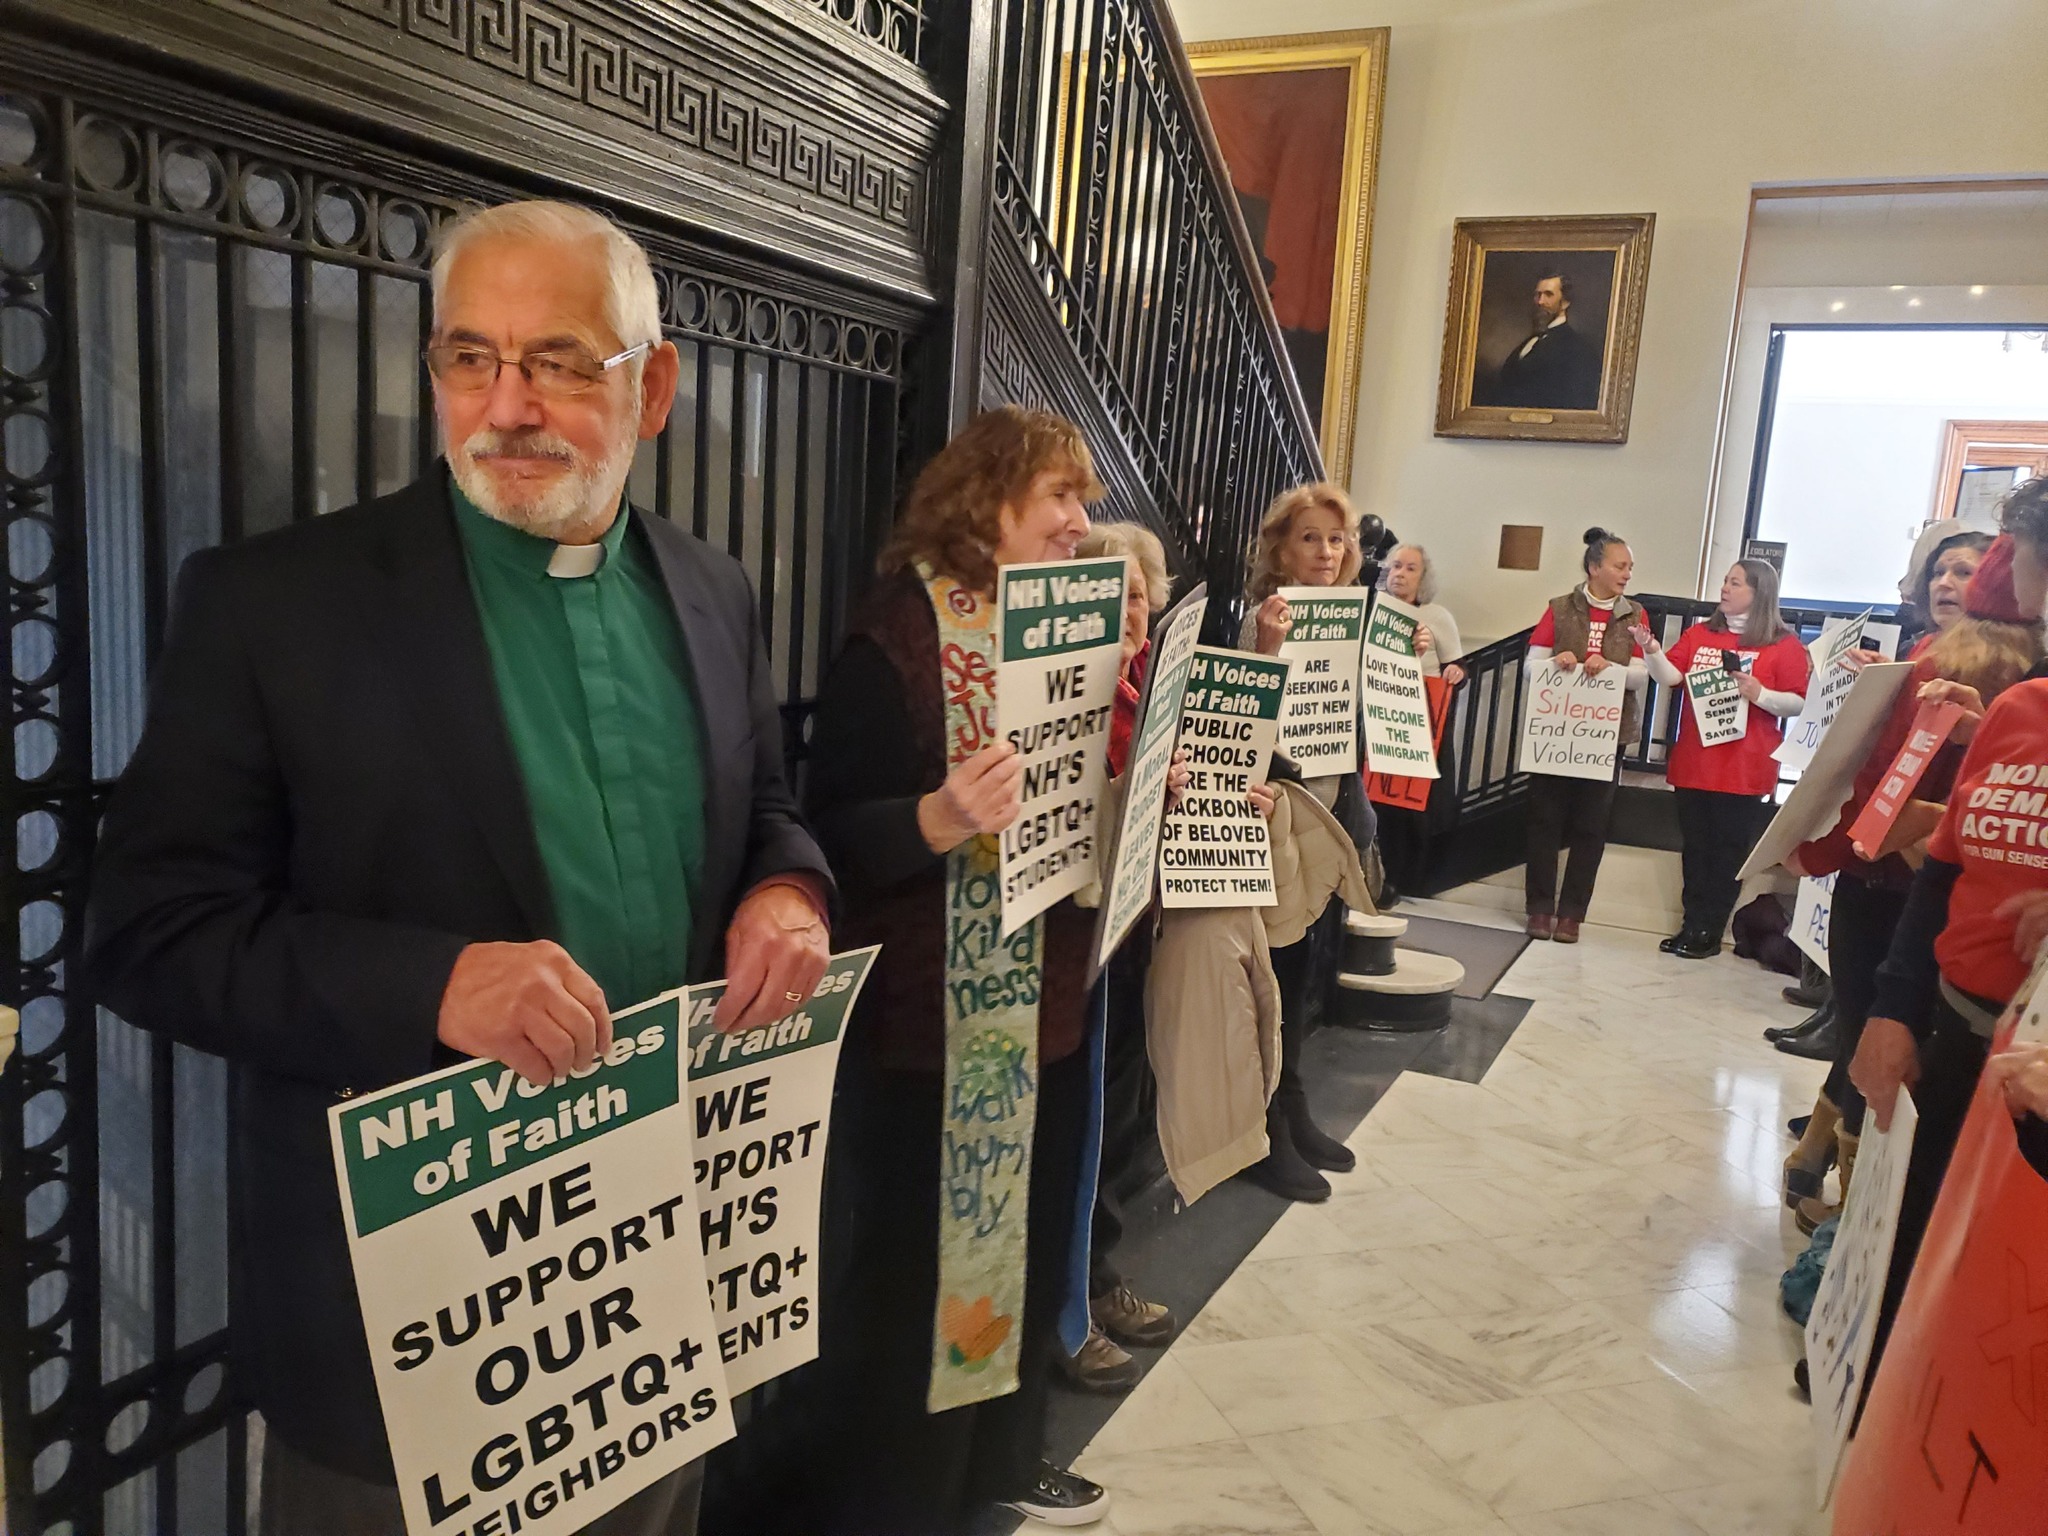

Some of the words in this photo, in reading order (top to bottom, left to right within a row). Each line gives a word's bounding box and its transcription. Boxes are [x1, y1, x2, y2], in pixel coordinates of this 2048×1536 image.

[1007, 578, 1046, 611] NH
[1050, 573, 1121, 605] Voices
[1289, 604, 1308, 620] NH
[1312, 602, 1360, 620] Voices
[1374, 608, 1388, 626] NH
[1388, 614, 1414, 639] Voices
[1022, 617, 1051, 650] of
[1053, 611, 1106, 646] Faith
[1293, 627, 1309, 641] of
[1311, 624, 1347, 640] Faith
[1375, 631, 1385, 646] of
[1385, 634, 1406, 654] Faith
[1693, 654, 1724, 666] DEM
[1697, 646, 1723, 657] MOM
[1190, 658, 1209, 681] H
[1213, 661, 1281, 690] Voices
[1304, 659, 1331, 674] ARE
[1366, 654, 1389, 676] LOVE
[1390, 660, 1420, 682] YOUR
[1537, 668, 1563, 687] No
[1573, 671, 1616, 691] More
[1691, 672, 1712, 687] NH
[1046, 664, 1086, 704] WE
[1286, 680, 1339, 696] SEEKING
[1341, 679, 1351, 692] A
[1367, 674, 1420, 700] NEIGHBOR!
[1703, 683, 1716, 695] of
[1820, 682, 1834, 698] ARE
[1185, 688, 1208, 709] of
[1207, 689, 1261, 716] Faith
[1288, 702, 1319, 717] JUST
[1322, 700, 1350, 714] NEW
[1536, 688, 1621, 721] Silence
[1704, 706, 1738, 719] SENSE
[1709, 694, 1741, 707] COMM
[1826, 699, 1834, 711] IN
[1836, 692, 1849, 707] TH
[1367, 703, 1425, 728] WELCOME
[1821, 713, 1837, 728] IMA
[1007, 705, 1111, 755] SUPPORT
[1181, 716, 1254, 742] PUBLIC
[1283, 719, 1353, 740] HAMPSHIRE
[1385, 727, 1411, 744] THE
[1528, 717, 1566, 737] End
[1572, 720, 1616, 741] Gun
[1705, 727, 1738, 740] SAVES
[1182, 743, 1258, 768] CHOOLS
[1289, 740, 1350, 759] ECONOMY
[1372, 742, 1430, 763] IMMIGRANT
[1533, 741, 1616, 767] Violence
[1021, 749, 1085, 803] NH'S
[1185, 770, 1208, 790] RE
[1213, 773, 1248, 792] THE
[1968, 786, 2048, 819] DEM
[1004, 797, 1094, 864] LGBTQ+
[1163, 822, 1183, 841] OF
[1188, 824, 1266, 843] BELOVED
[1006, 835, 1093, 904] STUDENTS
[1163, 847, 1267, 867] COMMUNITY
[1981, 846, 2005, 861] GUN
[2006, 850, 2048, 870] SENSE
[1165, 878, 1227, 893] PROTECT
[1230, 878, 1272, 893] THEM!
[949, 965, 1041, 1021] ness
[689, 997, 717, 1028] H
[718, 1011, 813, 1062] Faith
[696, 1076, 772, 1139] WE
[359, 1089, 456, 1160] NH
[412, 1137, 473, 1196] of
[487, 1084, 628, 1168] Faith
[946, 1130, 1025, 1178] hum
[470, 1162, 597, 1258] WE
[700, 1186, 778, 1256] H'S
[391, 1194, 684, 1372] SUPPORT
[707, 1246, 808, 1313] TQ+
[718, 1296, 810, 1365] ENTS
[475, 1286, 642, 1406] OUR
[421, 1337, 703, 1528] LGBTQ+
[455, 1387, 717, 1536] EIGHBORS
